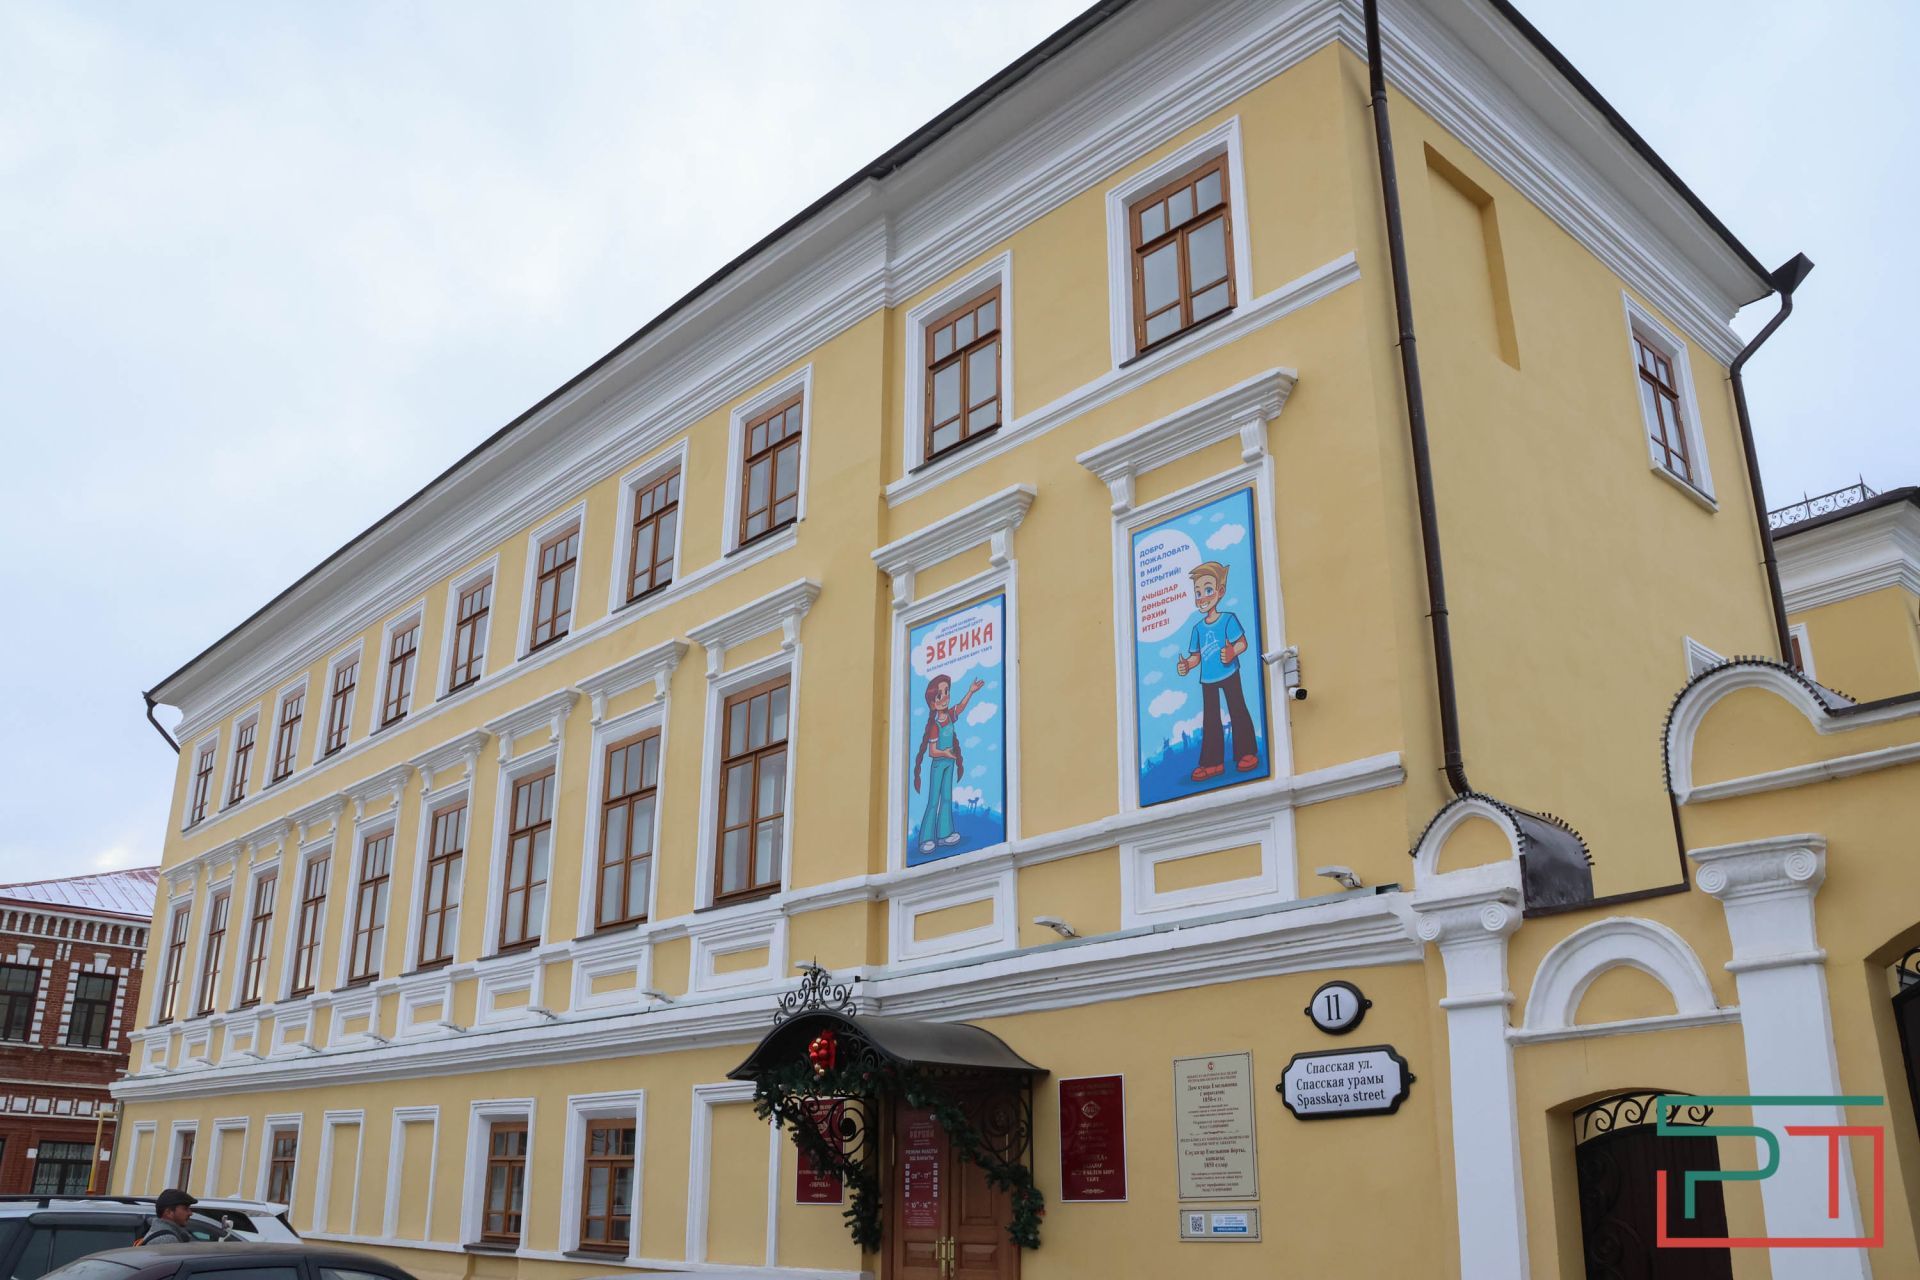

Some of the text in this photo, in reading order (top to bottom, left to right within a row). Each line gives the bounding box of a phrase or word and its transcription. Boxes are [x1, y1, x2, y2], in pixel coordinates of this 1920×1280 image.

[1139, 543, 1164, 559] ДОБРО
[1140, 544, 1190, 567] ПОЖАЛОВАТЬ
[1140, 566, 1182, 587] ОТКРЫТИЙ!
[1146, 564, 1162, 575] МИР
[1141, 583, 1178, 602] АЧЫШЛАР
[1142, 618, 1170, 632] ИТЕГЕЗ!
[926, 622, 993, 665] ЭВРИКА
[1324, 993, 1343, 1021] 11
[1306, 1059, 1373, 1075] Спасская ул.
[1296, 1074, 1385, 1091] Спасская урамы
[1297, 1088, 1386, 1109] Spasskaya street
